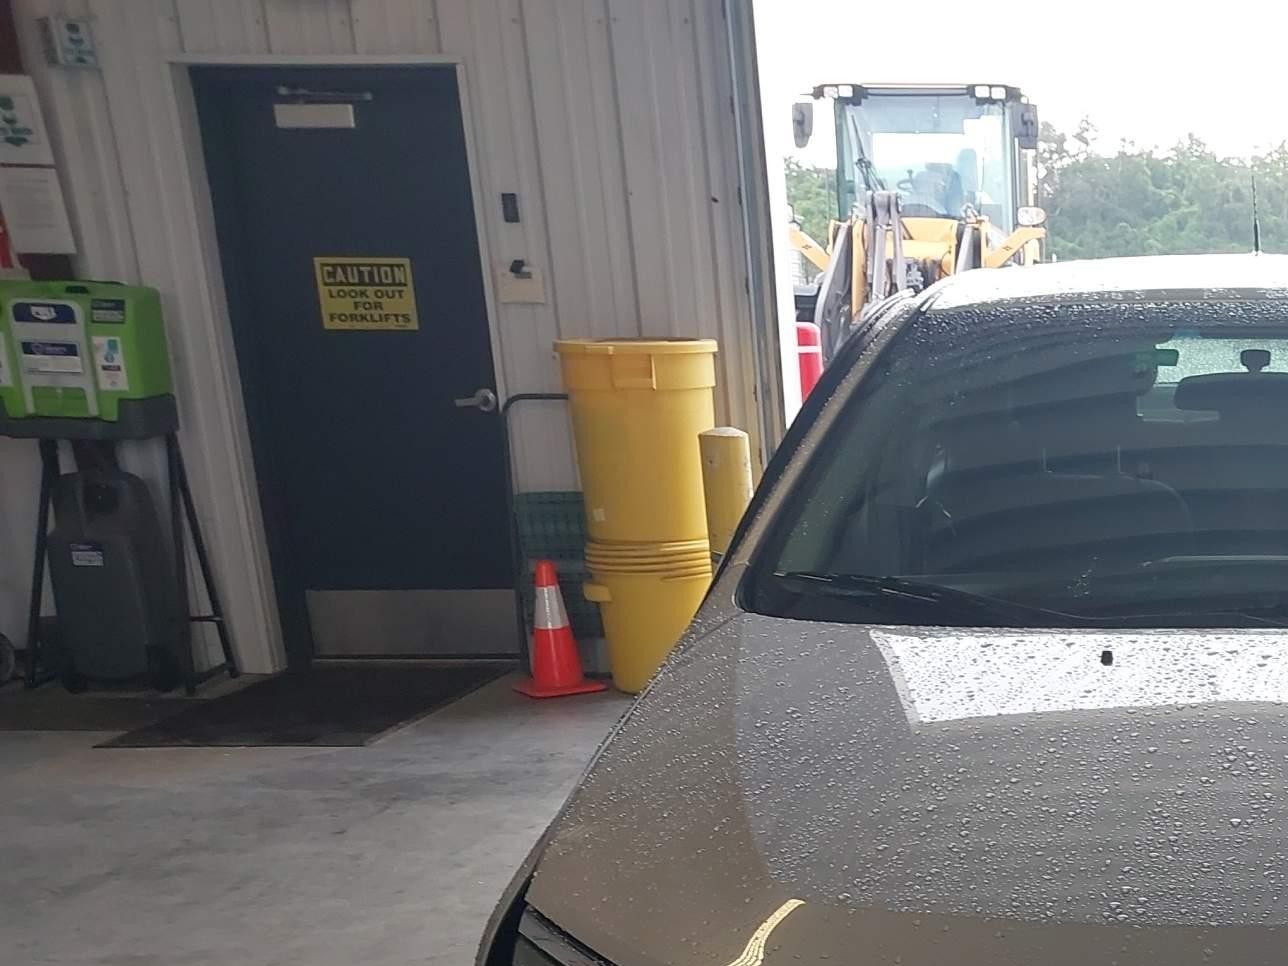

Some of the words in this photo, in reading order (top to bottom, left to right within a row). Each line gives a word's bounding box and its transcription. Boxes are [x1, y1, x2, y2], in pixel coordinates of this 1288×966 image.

[322, 266, 406, 284] CAUTION
[328, 289, 369, 299] LOOK
[374, 289, 404, 299] OUT
[353, 301, 383, 311] FOR
[329, 313, 410, 323] FORKLIFTS
